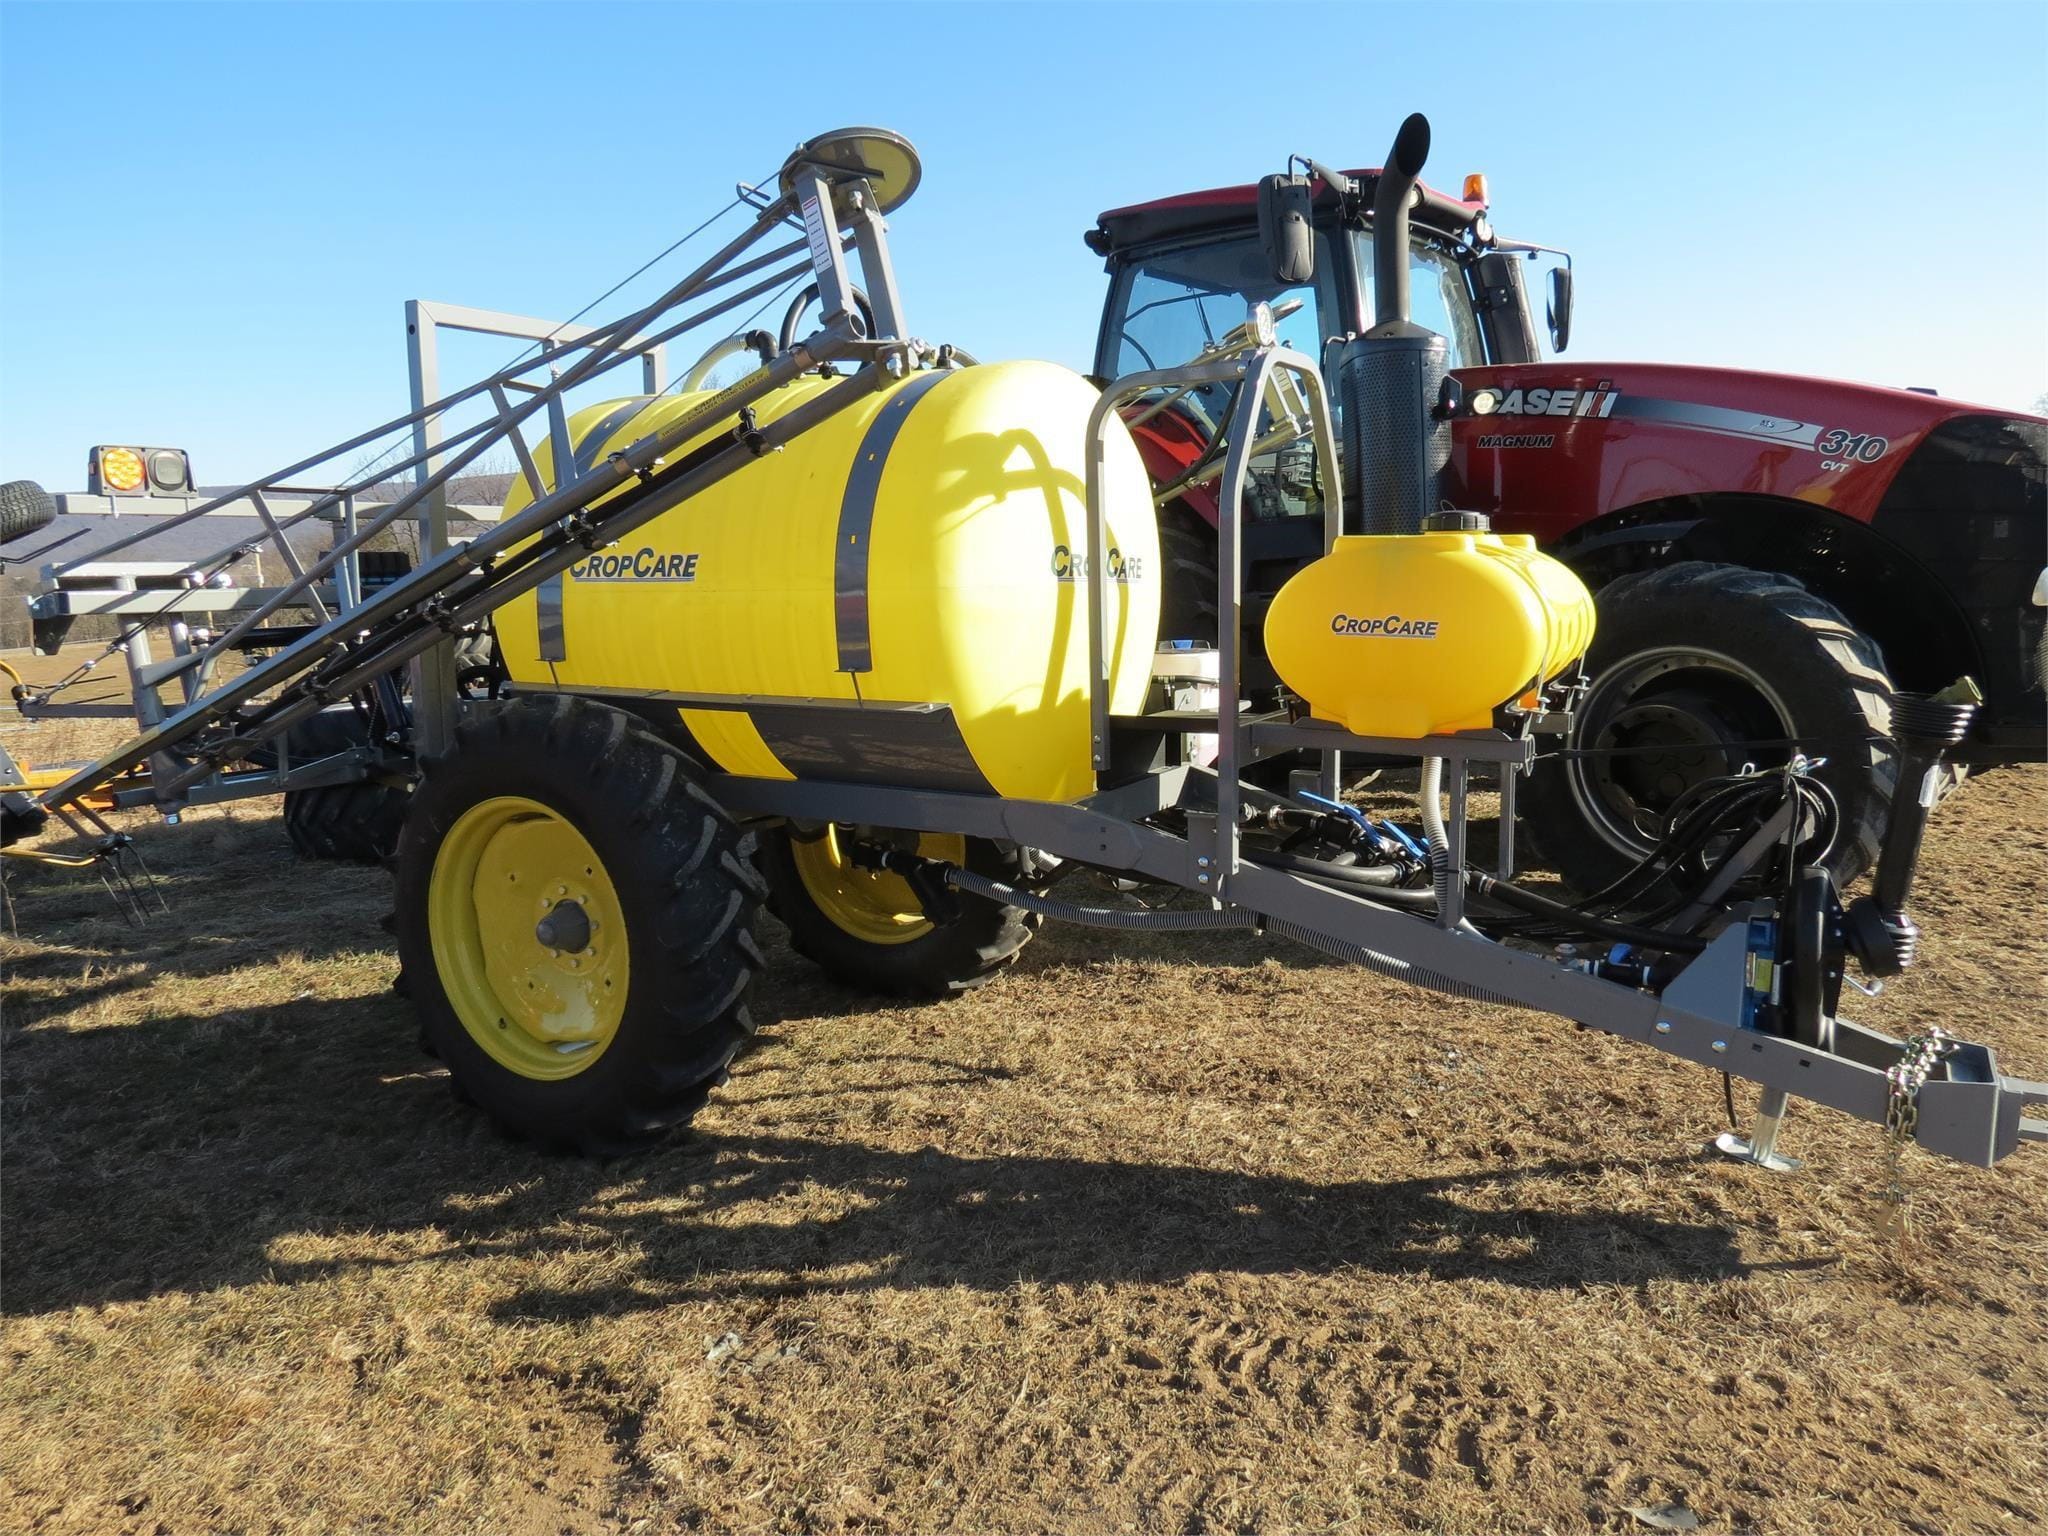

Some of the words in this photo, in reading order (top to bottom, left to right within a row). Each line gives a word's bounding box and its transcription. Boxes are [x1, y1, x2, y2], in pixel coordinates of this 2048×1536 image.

[1477, 435, 1554, 448] MAGNUM
[1819, 429, 1888, 463] 310
[1820, 460, 1850, 472] CVT
